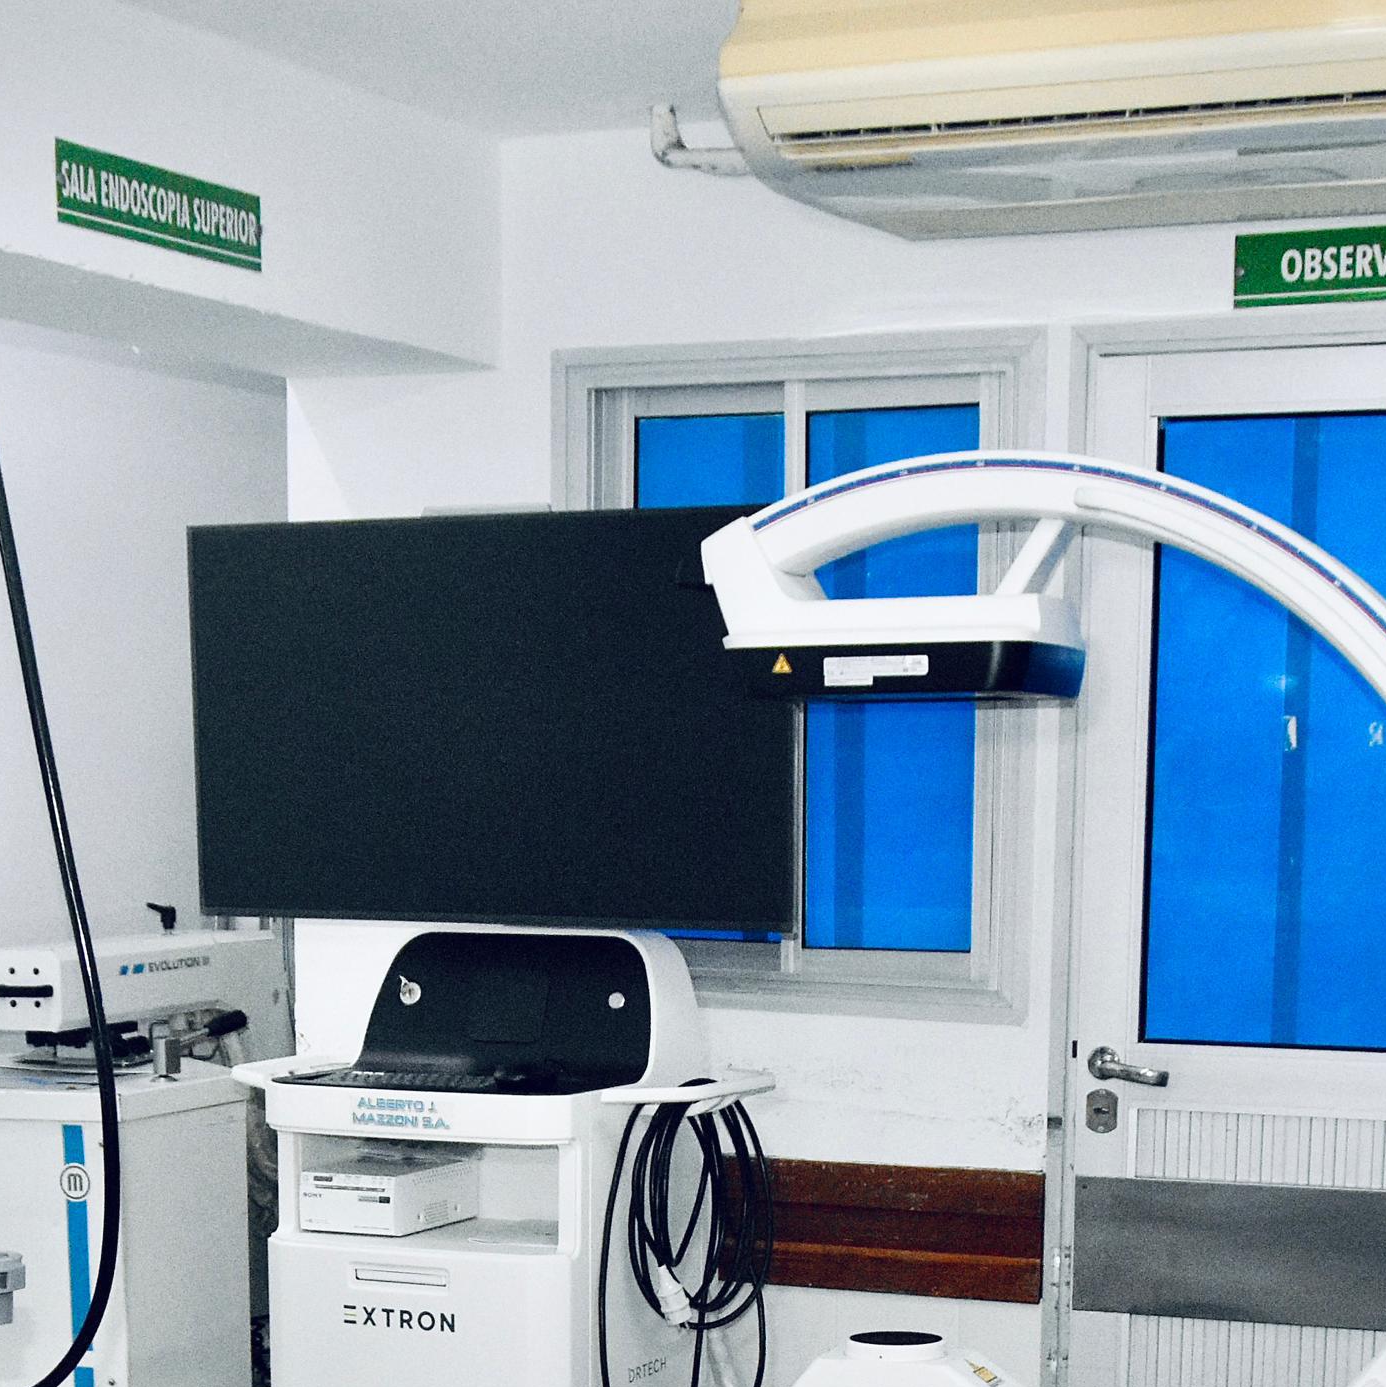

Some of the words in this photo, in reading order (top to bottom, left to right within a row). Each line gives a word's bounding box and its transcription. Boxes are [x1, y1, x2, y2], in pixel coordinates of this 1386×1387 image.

[61, 159, 97, 205] SALA
[100, 170, 190, 230] ENDOSCOPIA
[193, 197, 258, 246] SUPERIOR
[148, 956, 200, 972] EVOLUTION
[357, 1096, 425, 1113] ALBERTO
[352, 1111, 419, 1129] MAZZONI
[343, 1304, 456, 1333] EXTRON
[627, 1356, 667, 1384] DRTECH
